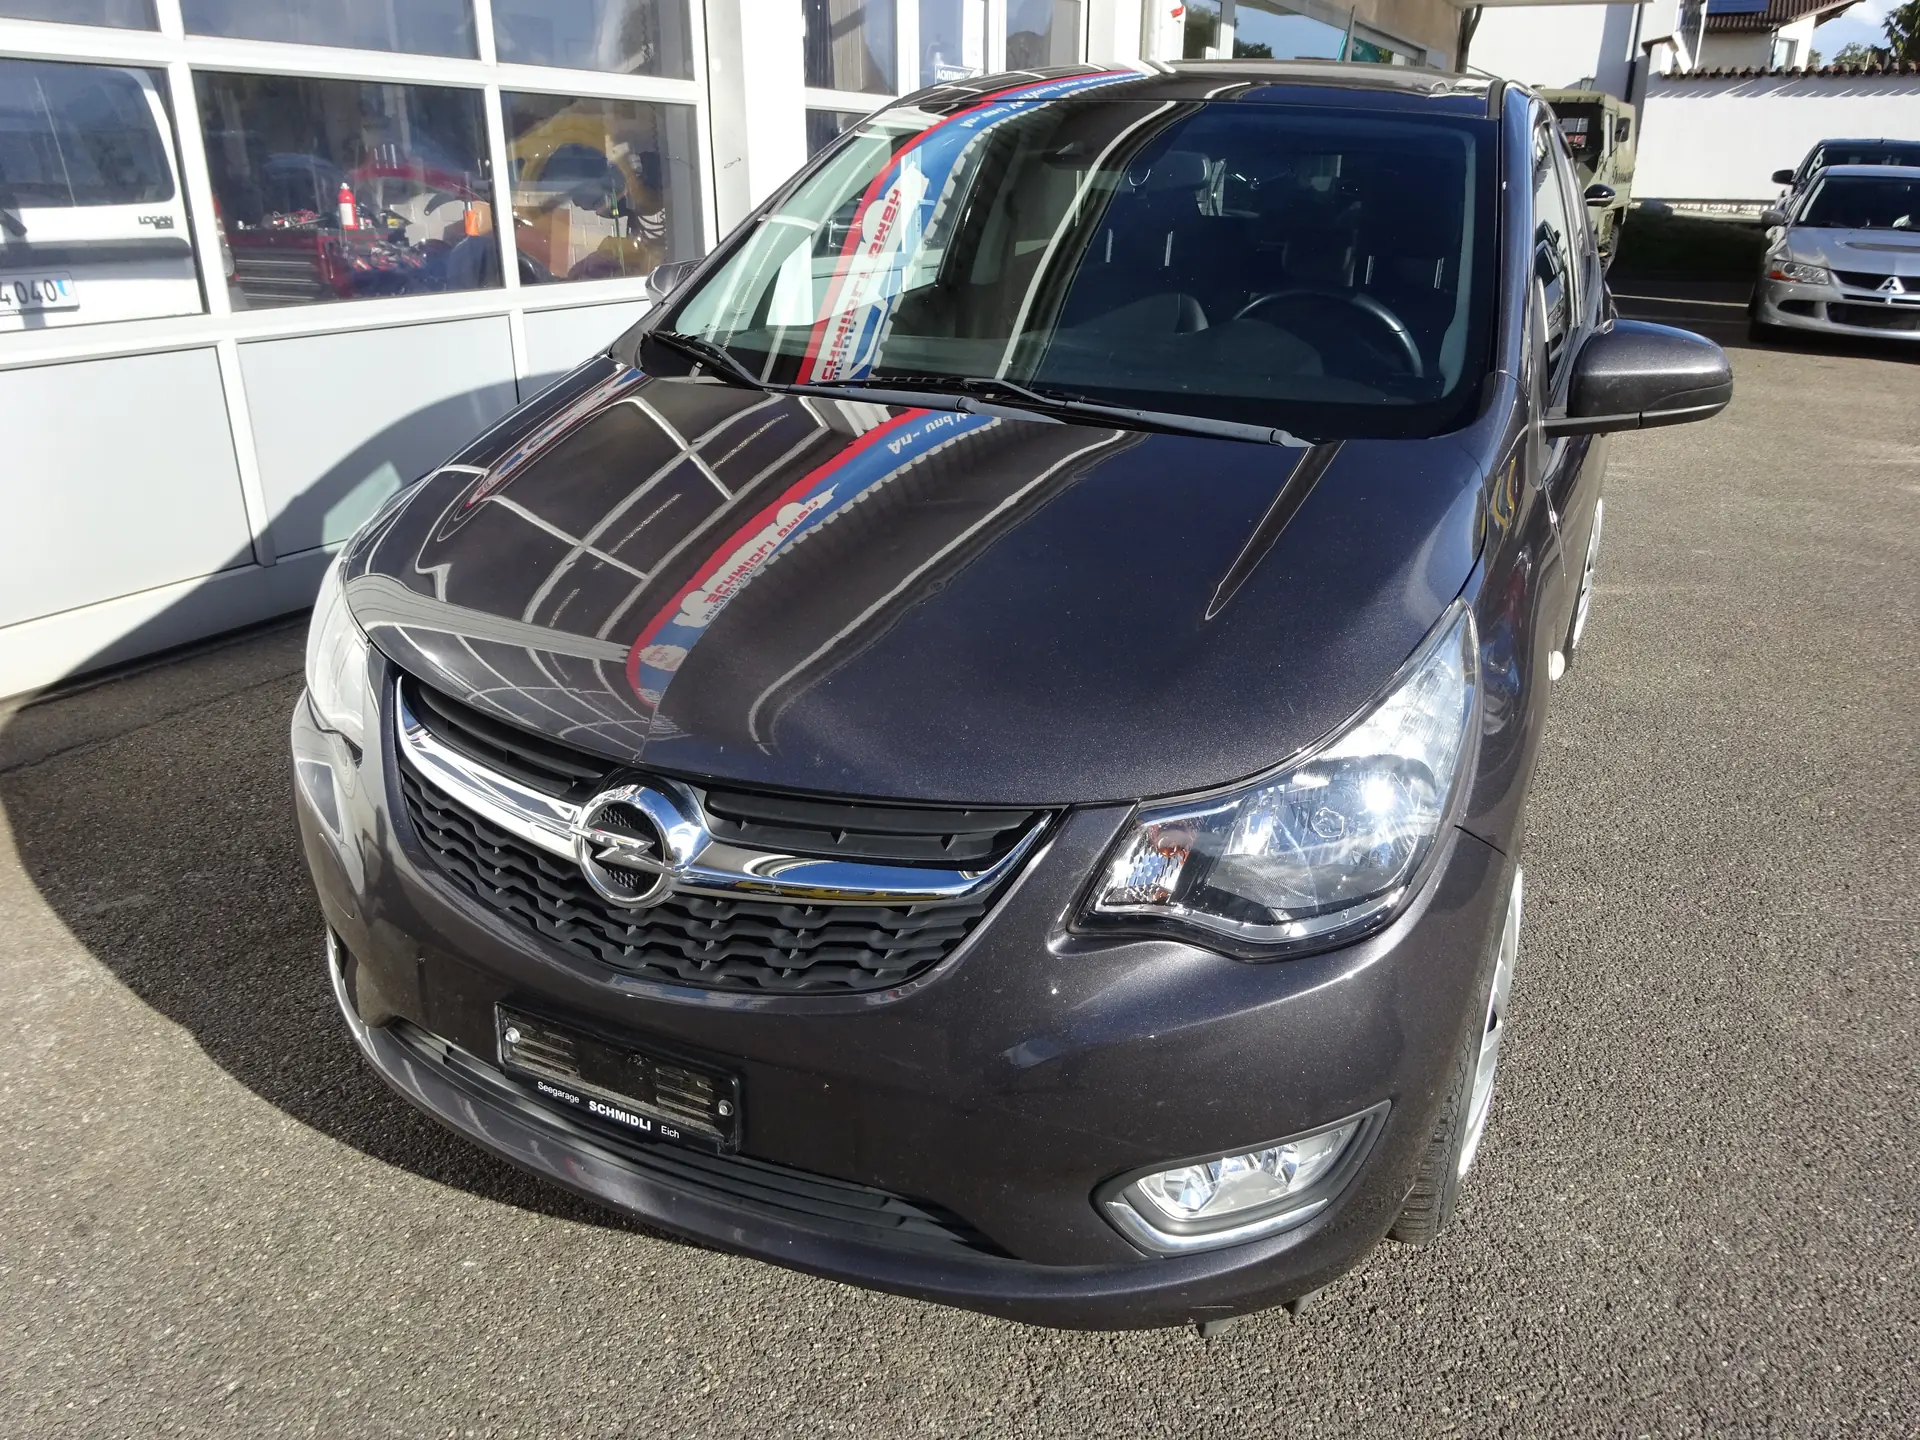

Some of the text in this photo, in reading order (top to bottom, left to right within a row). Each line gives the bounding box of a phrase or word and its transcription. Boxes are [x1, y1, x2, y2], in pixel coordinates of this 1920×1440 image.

[138, 216, 173, 225] LOGAN
[537, 1082, 680, 1139] Seegarage SCHMIDLI Eich
